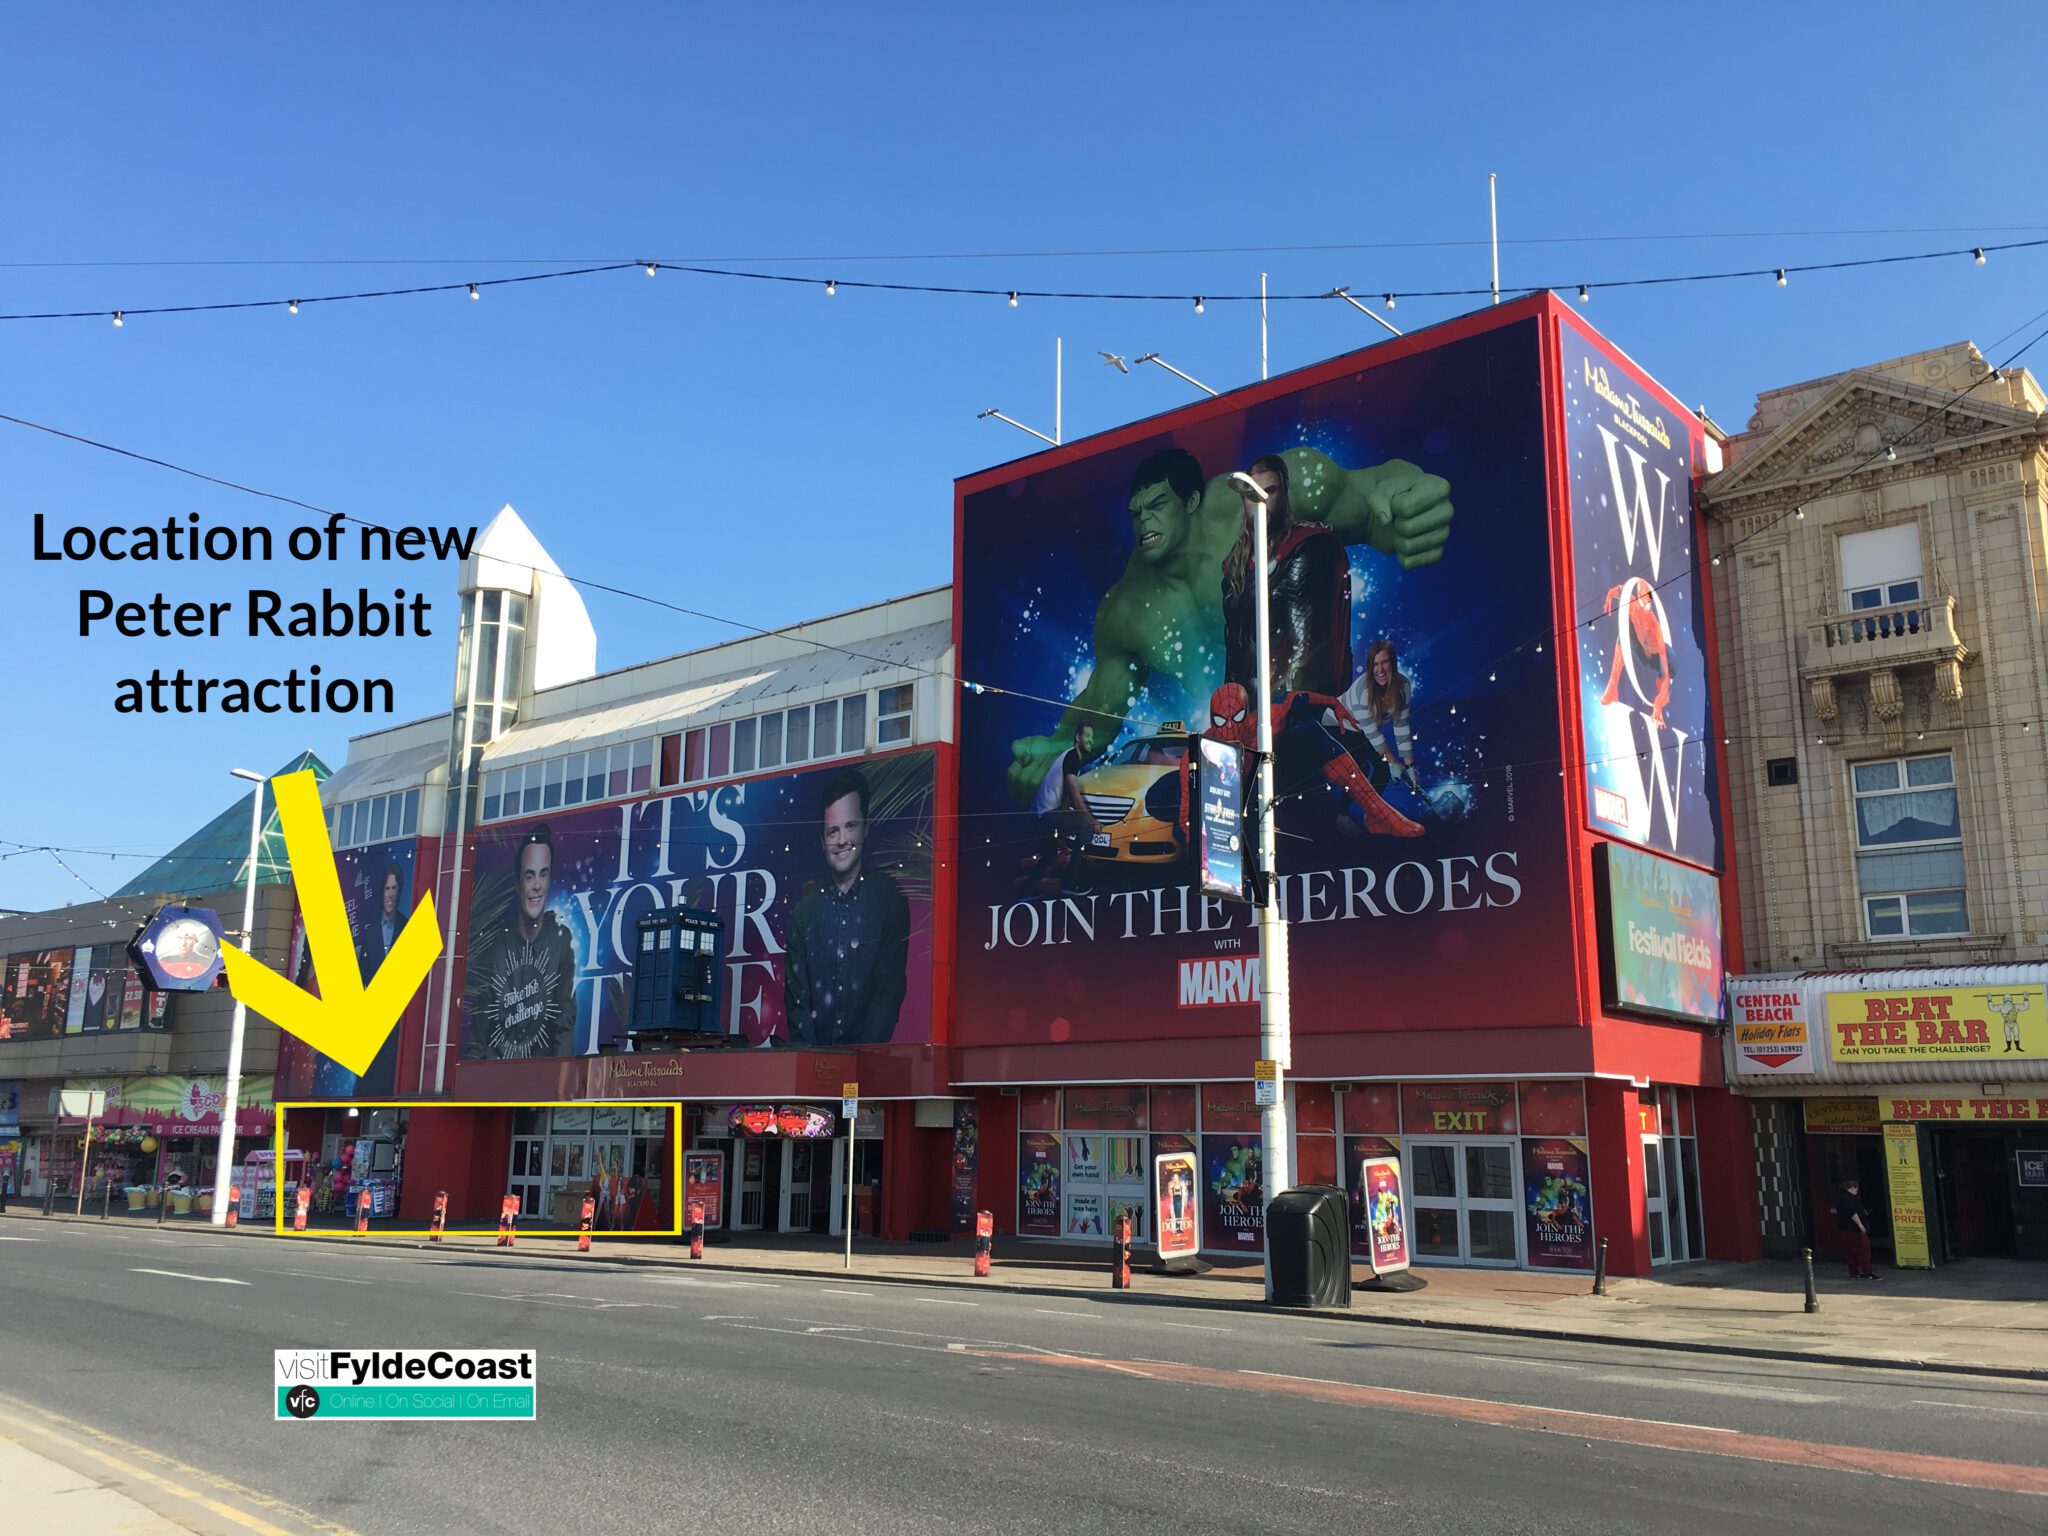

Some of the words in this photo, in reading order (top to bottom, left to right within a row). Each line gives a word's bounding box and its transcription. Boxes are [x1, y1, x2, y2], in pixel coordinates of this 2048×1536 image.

[1584, 356, 1630, 417] Madame
[1628, 393, 1672, 451] Tussauds
[1613, 412, 1650, 450] BLACKPOOL
[1507, 781, 1515, 813] MARVEL
[1594, 786, 1628, 828] MARVEL
[613, 783, 748, 884] IT'S
[1092, 834, 1108, 844] OOL
[983, 894, 1100, 951] JOIN
[1109, 884, 1233, 939] THE
[1213, 938, 1242, 950] WITH
[1628, 919, 1677, 962] Festival
[1678, 932, 1712, 970] Fields
[1180, 957, 1261, 1006] MARV
[503, 987, 525, 1009] Take
[524, 978, 540, 997] the
[1736, 993, 1801, 1009] CENTRAL
[504, 1001, 545, 1029] challenge
[572, 960, 777, 1057] TE
[1745, 1007, 1793, 1022] BEACH
[1864, 996, 1953, 1022] BEAT
[1740, 1026, 1776, 1042] Holiday
[1777, 1024, 1802, 1039] Flats
[1836, 1022, 1908, 1046] THE
[1916, 1019, 1990, 1044] BAR
[1756, 1045, 1780, 1054] (01253)
[1780, 1045, 1803, 1053] 628932
[1839, 1047, 1860, 1056] CAN
[1861, 1047, 1881, 1055] YOU
[1883, 1046, 1907, 1054] TAKE
[1909, 1046, 1927, 1054] THE
[1928, 1045, 1992, 1054] CHALLENGE?
[609, 1058, 644, 1079] Madame
[643, 1060, 685, 1077] Tussauds
[1891, 1099, 1963, 1119] BEAT
[1969, 1099, 2031, 1119] THE
[1432, 1111, 1488, 1131] EXIT
[172, 1125, 183, 1134] ICE
[184, 1125, 209, 1134] CREAM
[1084, 1164, 1097, 1172] your
[1547, 1162, 1564, 1170] MARVEL
[2024, 1160, 2045, 1171] ICE
[1090, 1197, 1097, 1205] of
[1027, 1207, 1055, 1216] HEROES
[1218, 1204, 1245, 1216] JOIN
[1249, 1205, 1264, 1216] TH
[1162, 1220, 1194, 1233] DOCTOR
[1894, 1215, 1926, 1224] PRIZE
[1536, 1223, 1559, 1232] JOIN
[1562, 1224, 1585, 1234] THE
[1540, 1232, 1582, 1243] HEROES
[1379, 1242, 1401, 1253] HEROES
